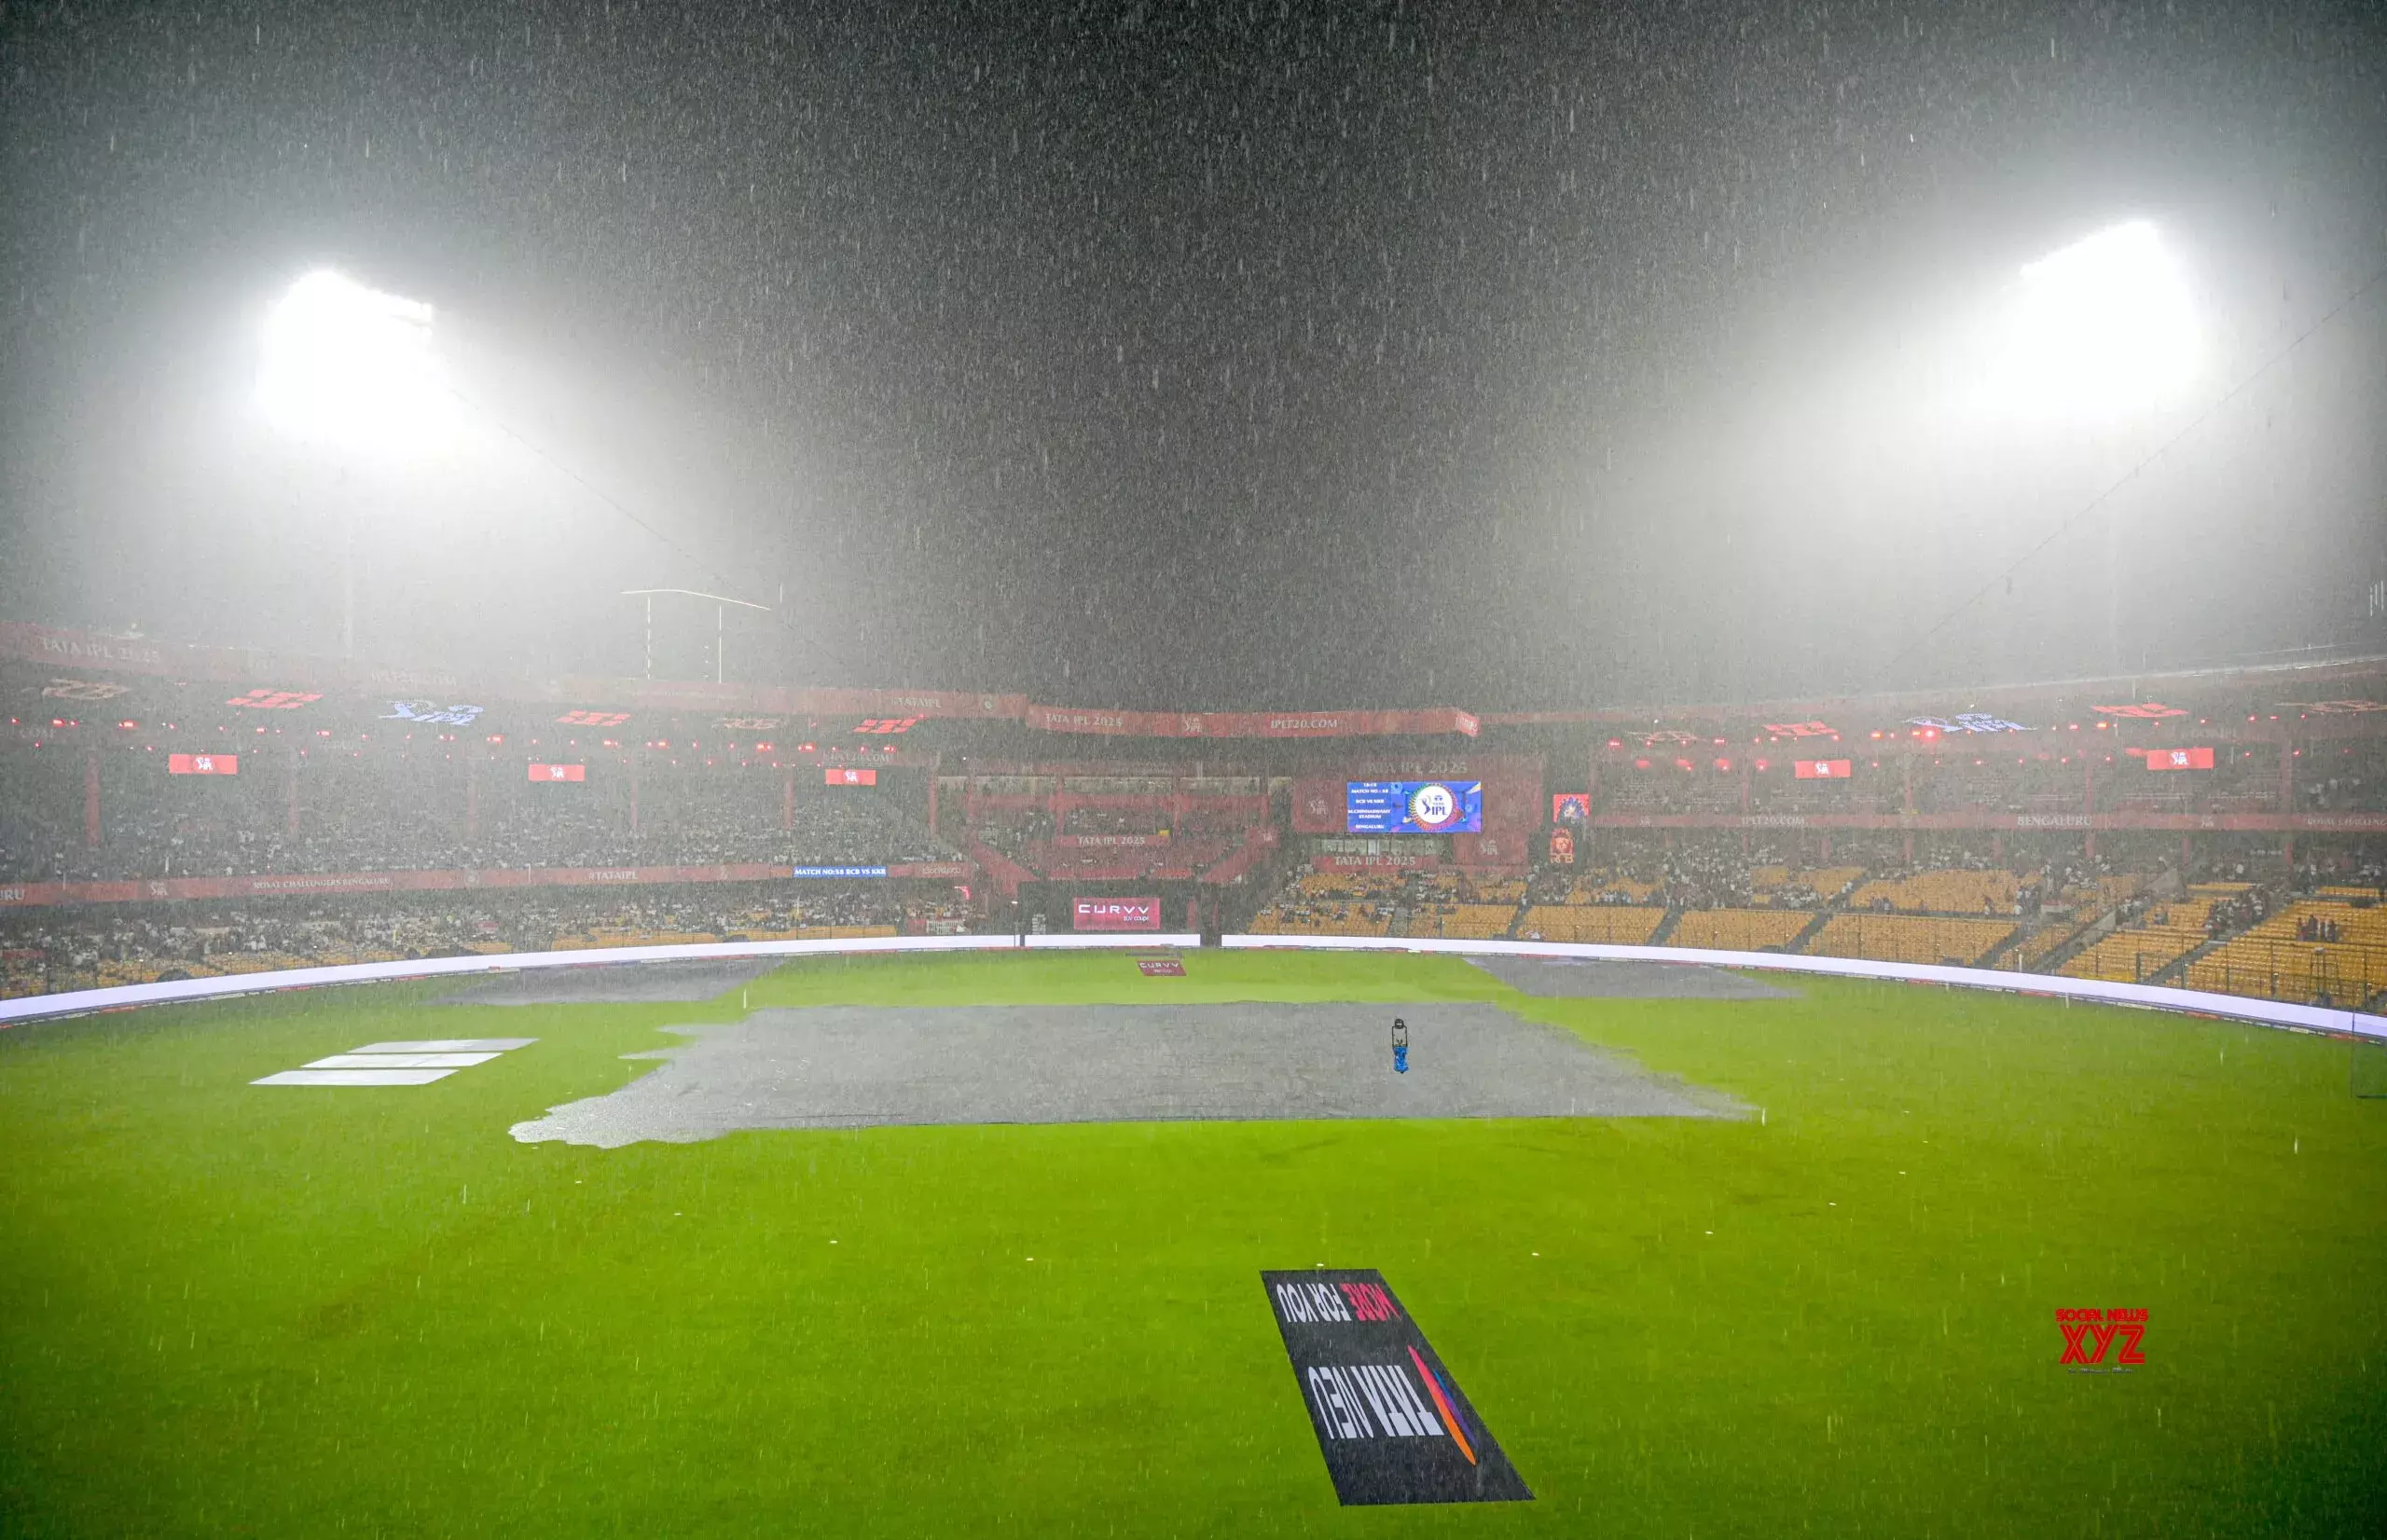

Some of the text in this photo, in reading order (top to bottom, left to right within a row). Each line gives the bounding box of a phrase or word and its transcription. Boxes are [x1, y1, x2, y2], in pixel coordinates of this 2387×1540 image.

[1045, 713, 1069, 723] TATA
[1431, 805, 1447, 816] IPL
[2017, 815, 2092, 826] BENGALURU
[1078, 835, 1100, 846] TATA
[1103, 835, 1118, 846] IPL
[1334, 856, 1416, 866] TATA IPL 2025
[588, 870, 638, 881] #TATAIPL
[1078, 904, 1150, 914] CURVV
[1276, 1283, 1400, 1323] MORE FOR YOU
[1308, 1365, 1444, 1439] TATA NEU
